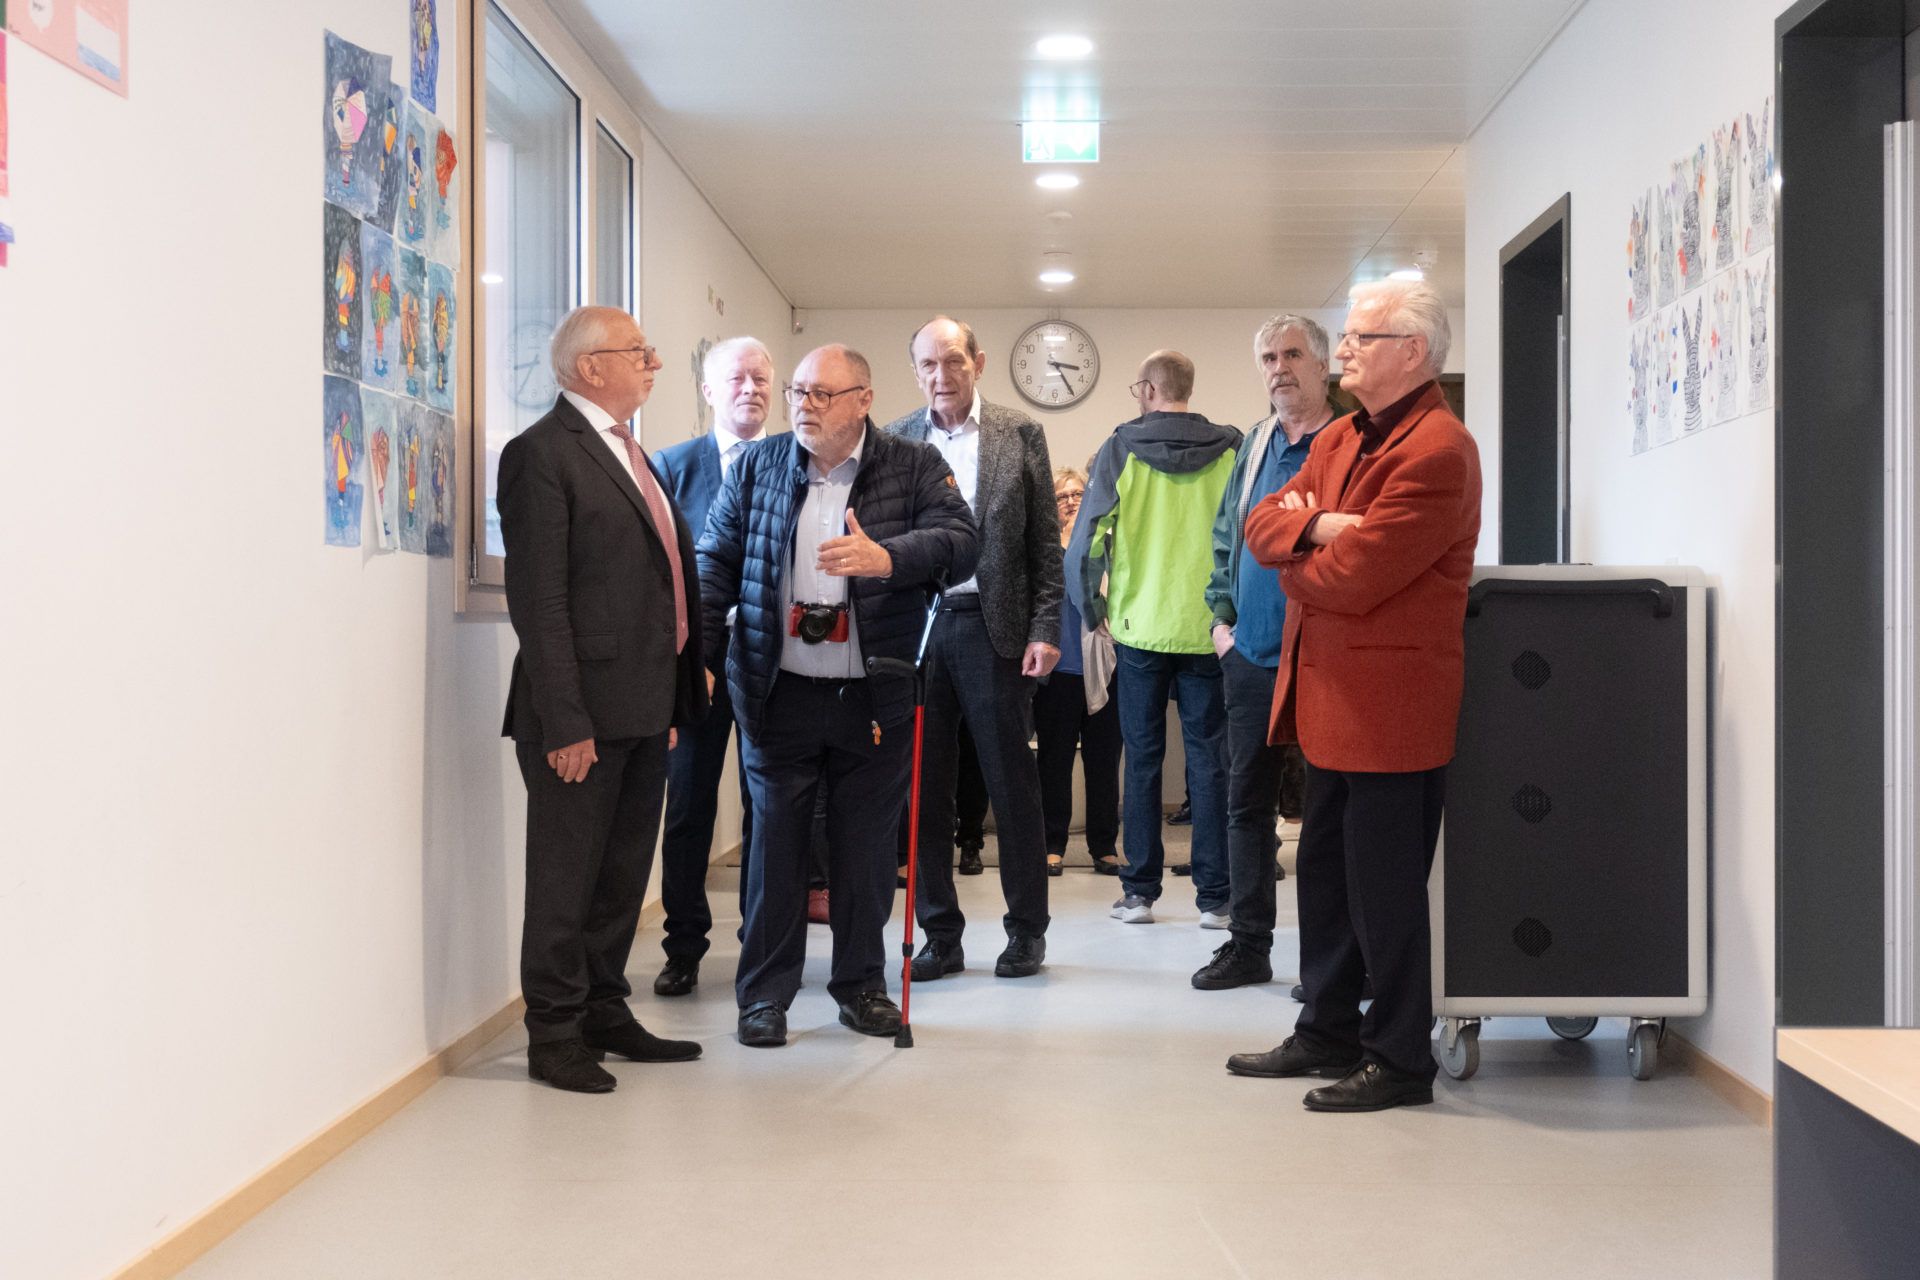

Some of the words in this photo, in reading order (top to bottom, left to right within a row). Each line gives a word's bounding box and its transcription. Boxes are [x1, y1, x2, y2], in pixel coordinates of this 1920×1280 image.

[1025, 345, 1035, 354] 10
[1078, 343, 1084, 353] 2
[1020, 360, 1027, 369] 9
[1083, 359, 1090, 368] 3
[1026, 375, 1032, 384] 8
[1078, 374, 1084, 383] 4
[1052, 389, 1058, 398] 6
